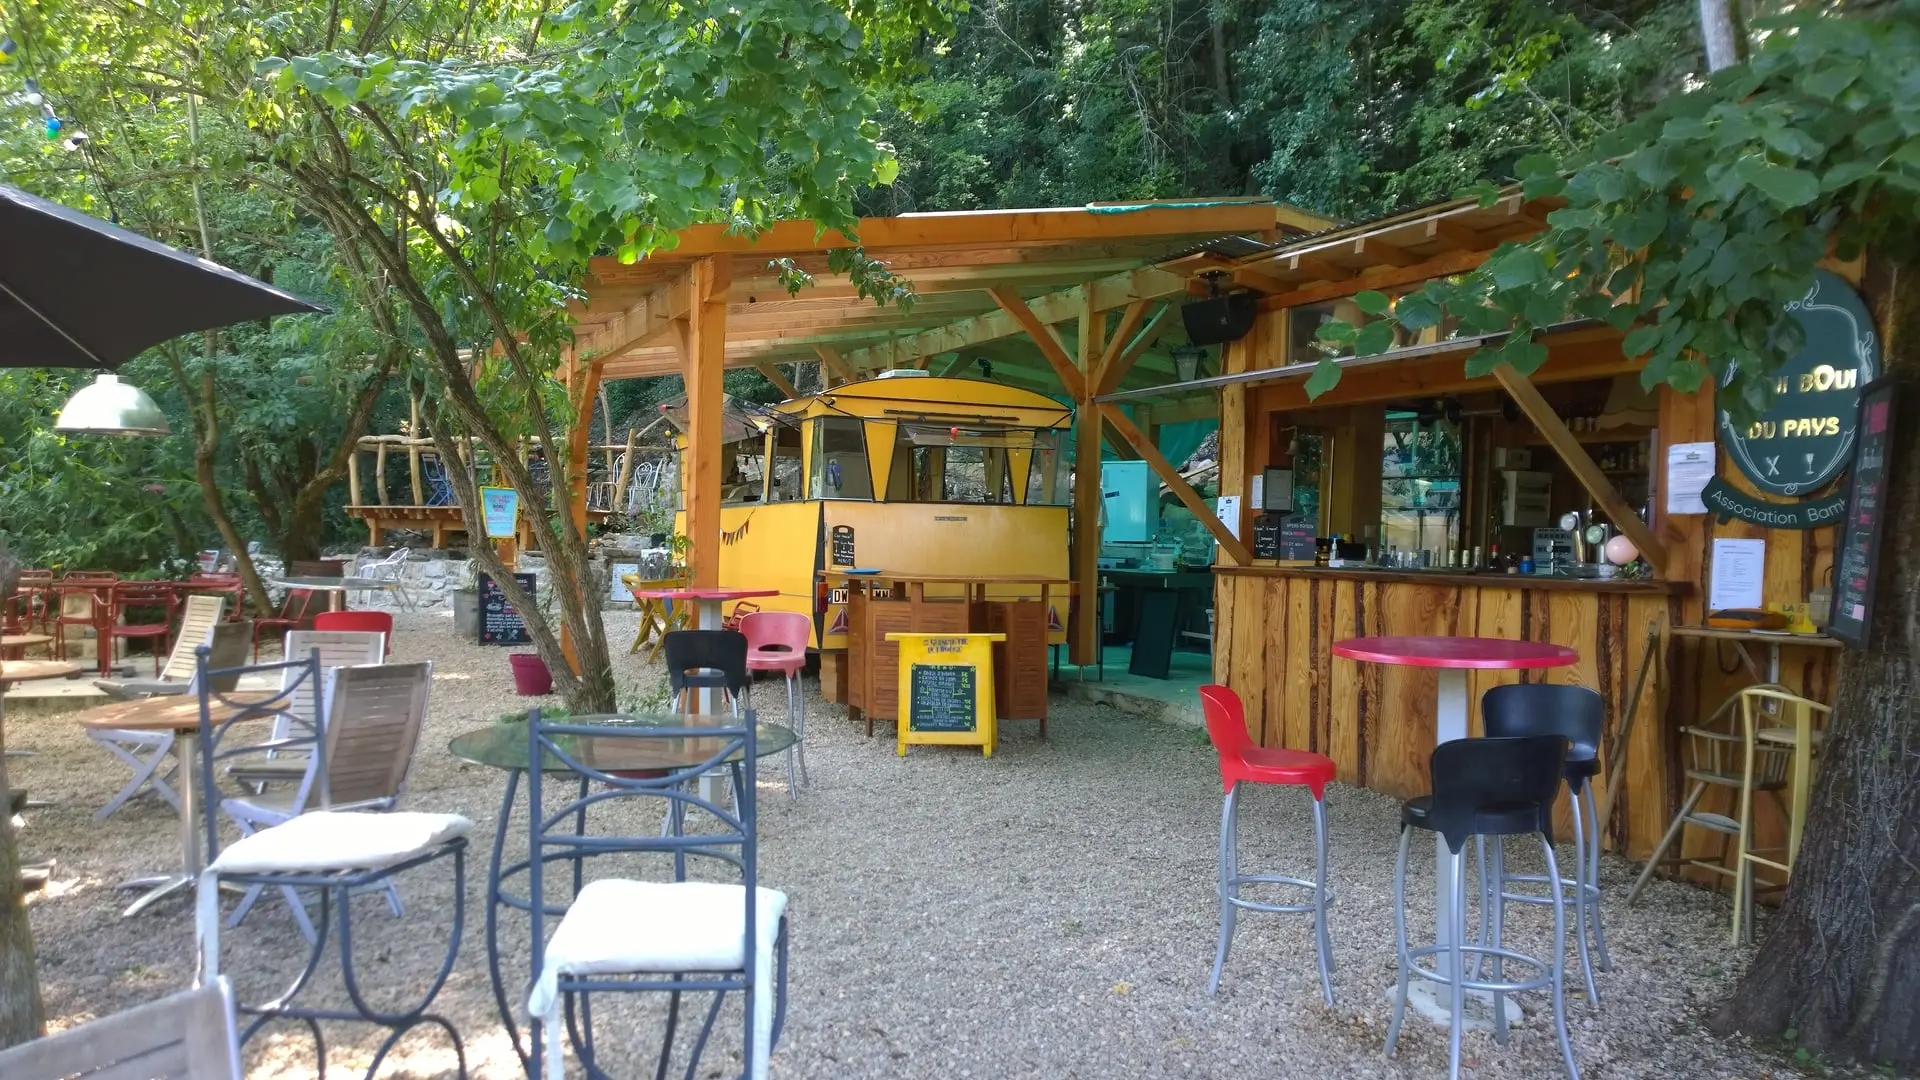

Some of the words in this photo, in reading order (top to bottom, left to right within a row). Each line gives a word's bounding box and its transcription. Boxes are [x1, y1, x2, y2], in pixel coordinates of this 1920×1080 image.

[1800, 365, 1857, 392] BOUI
[1748, 421, 1777, 439] DU
[1783, 416, 1840, 438] PAYS
[1712, 490, 1797, 524] Association
[834, 590, 848, 603] DW
